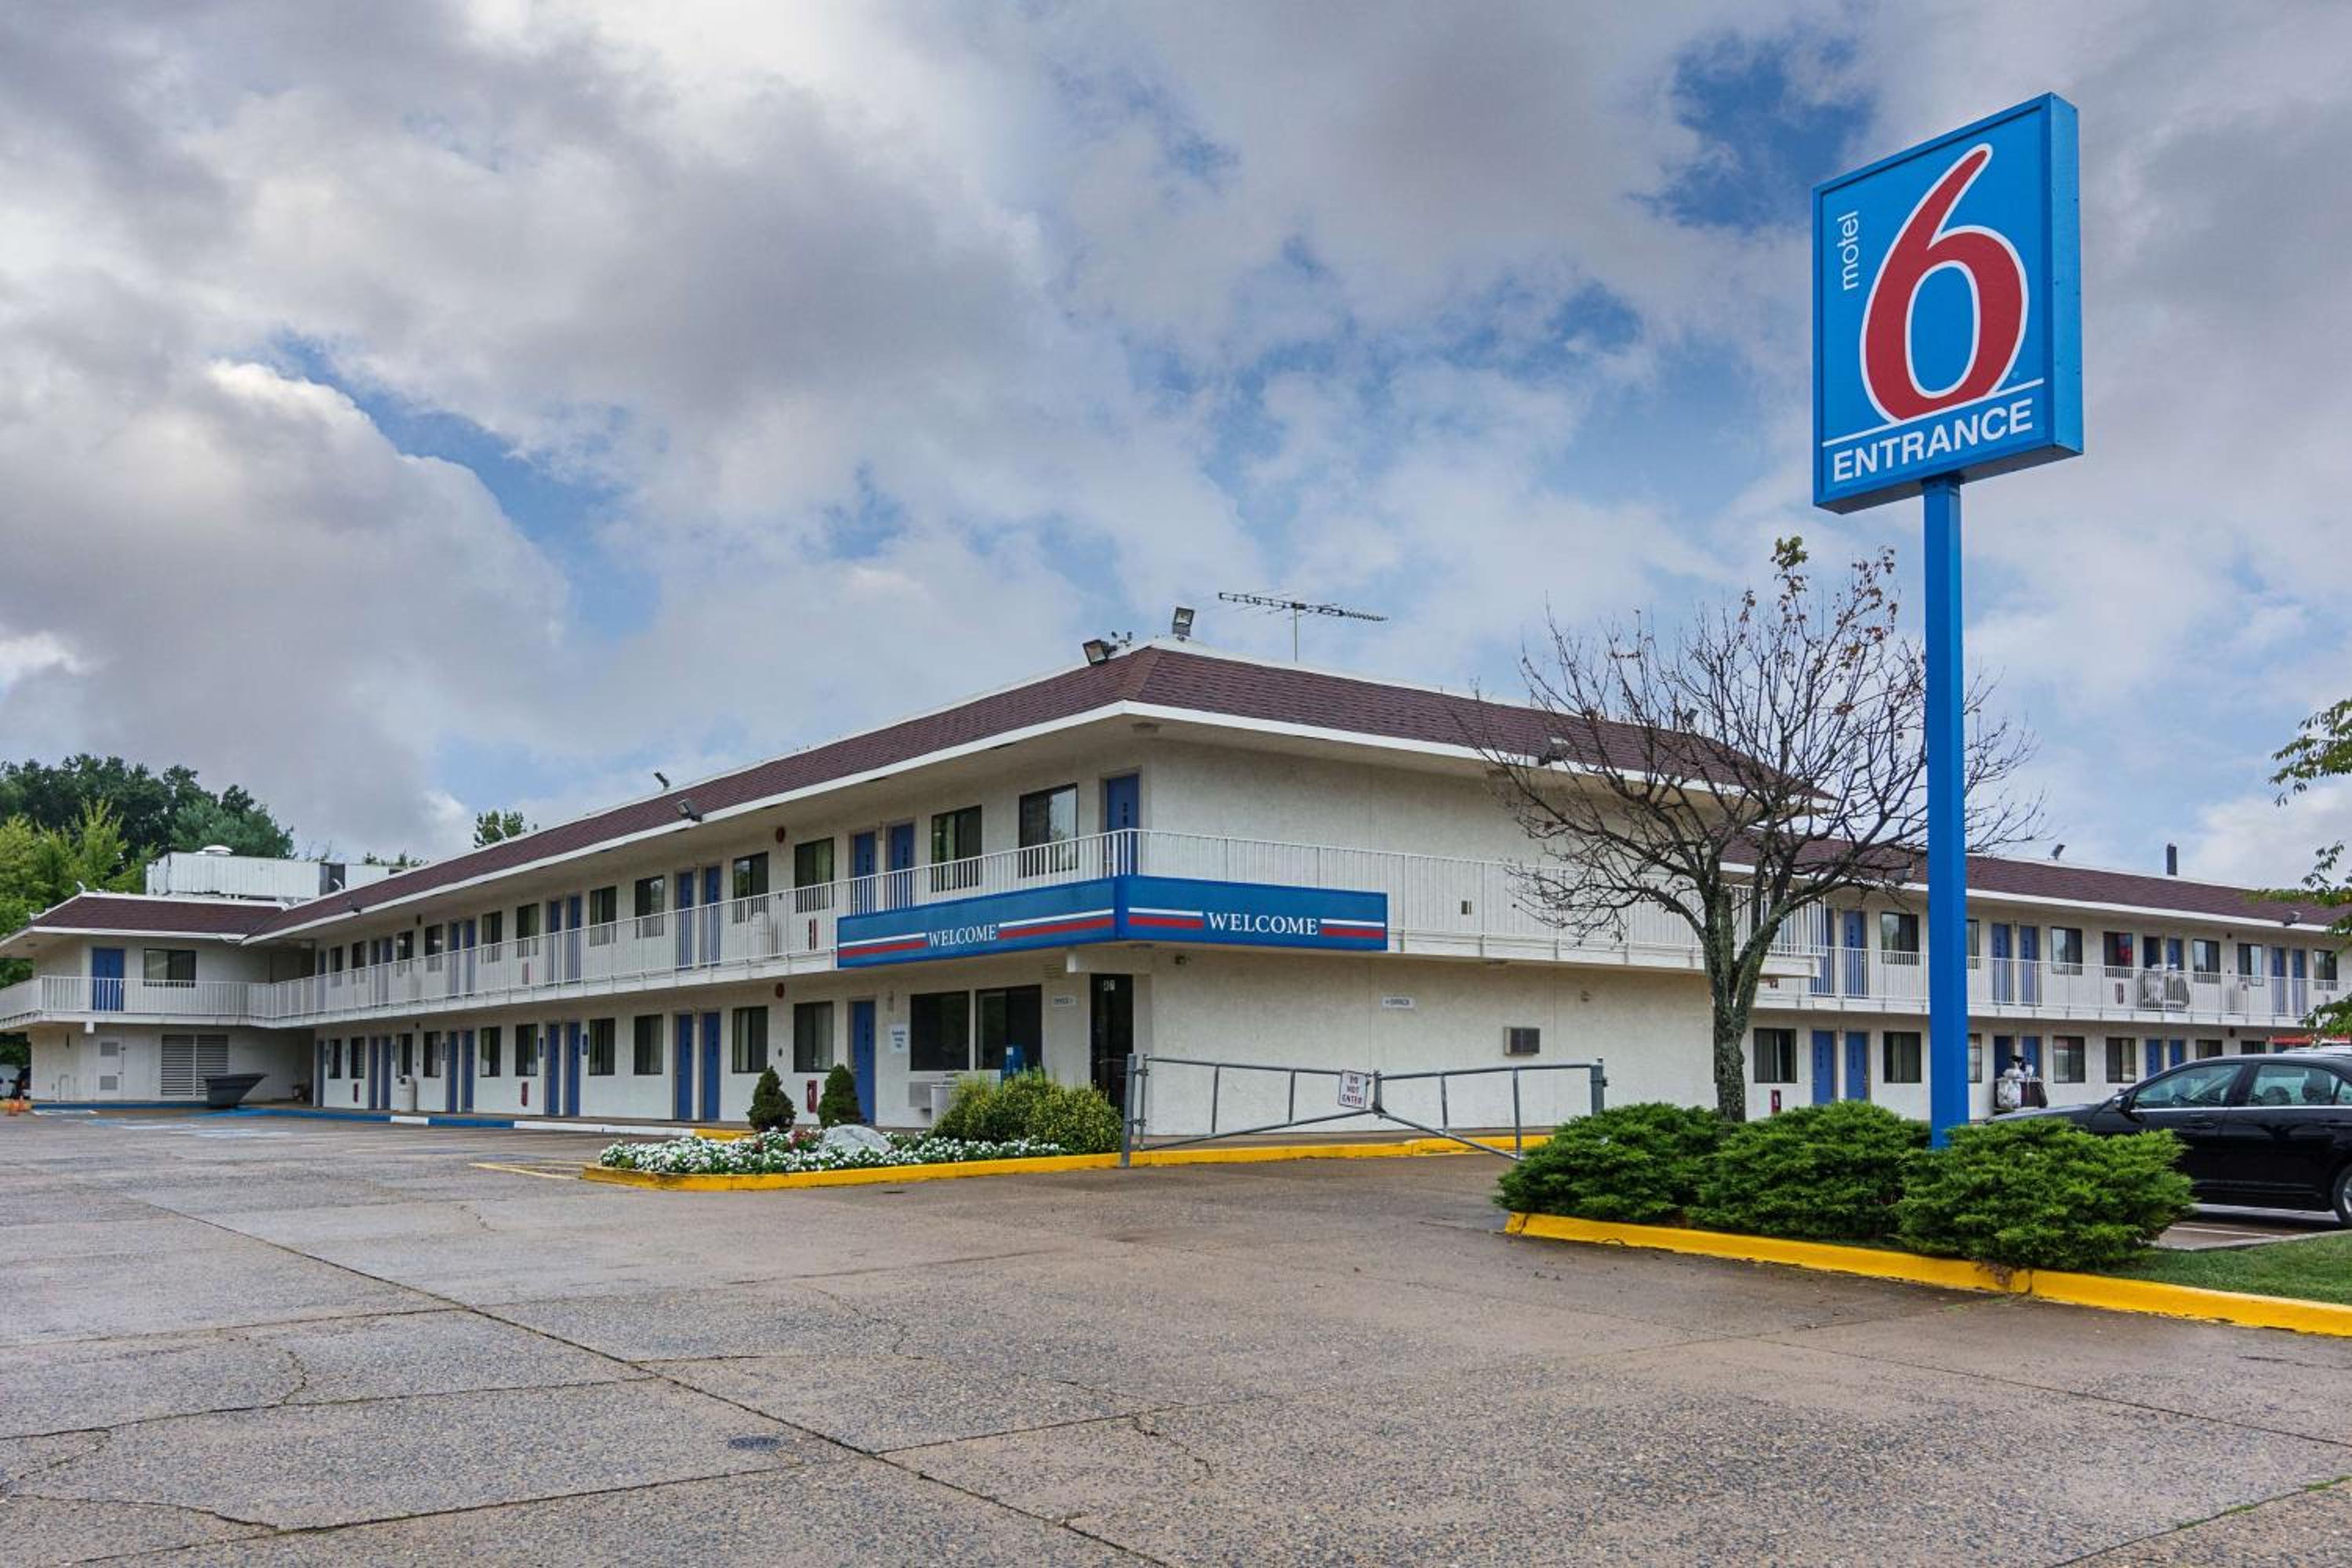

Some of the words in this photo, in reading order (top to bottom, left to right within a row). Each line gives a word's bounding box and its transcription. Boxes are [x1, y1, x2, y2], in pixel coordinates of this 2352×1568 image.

[1837, 211, 1859, 291] motel
[1860, 143, 2029, 424] 6
[1834, 397, 2033, 482] ENTRANCE
[928, 924, 996, 947] WELCOME
[1207, 912, 1318, 935] WELCOME
